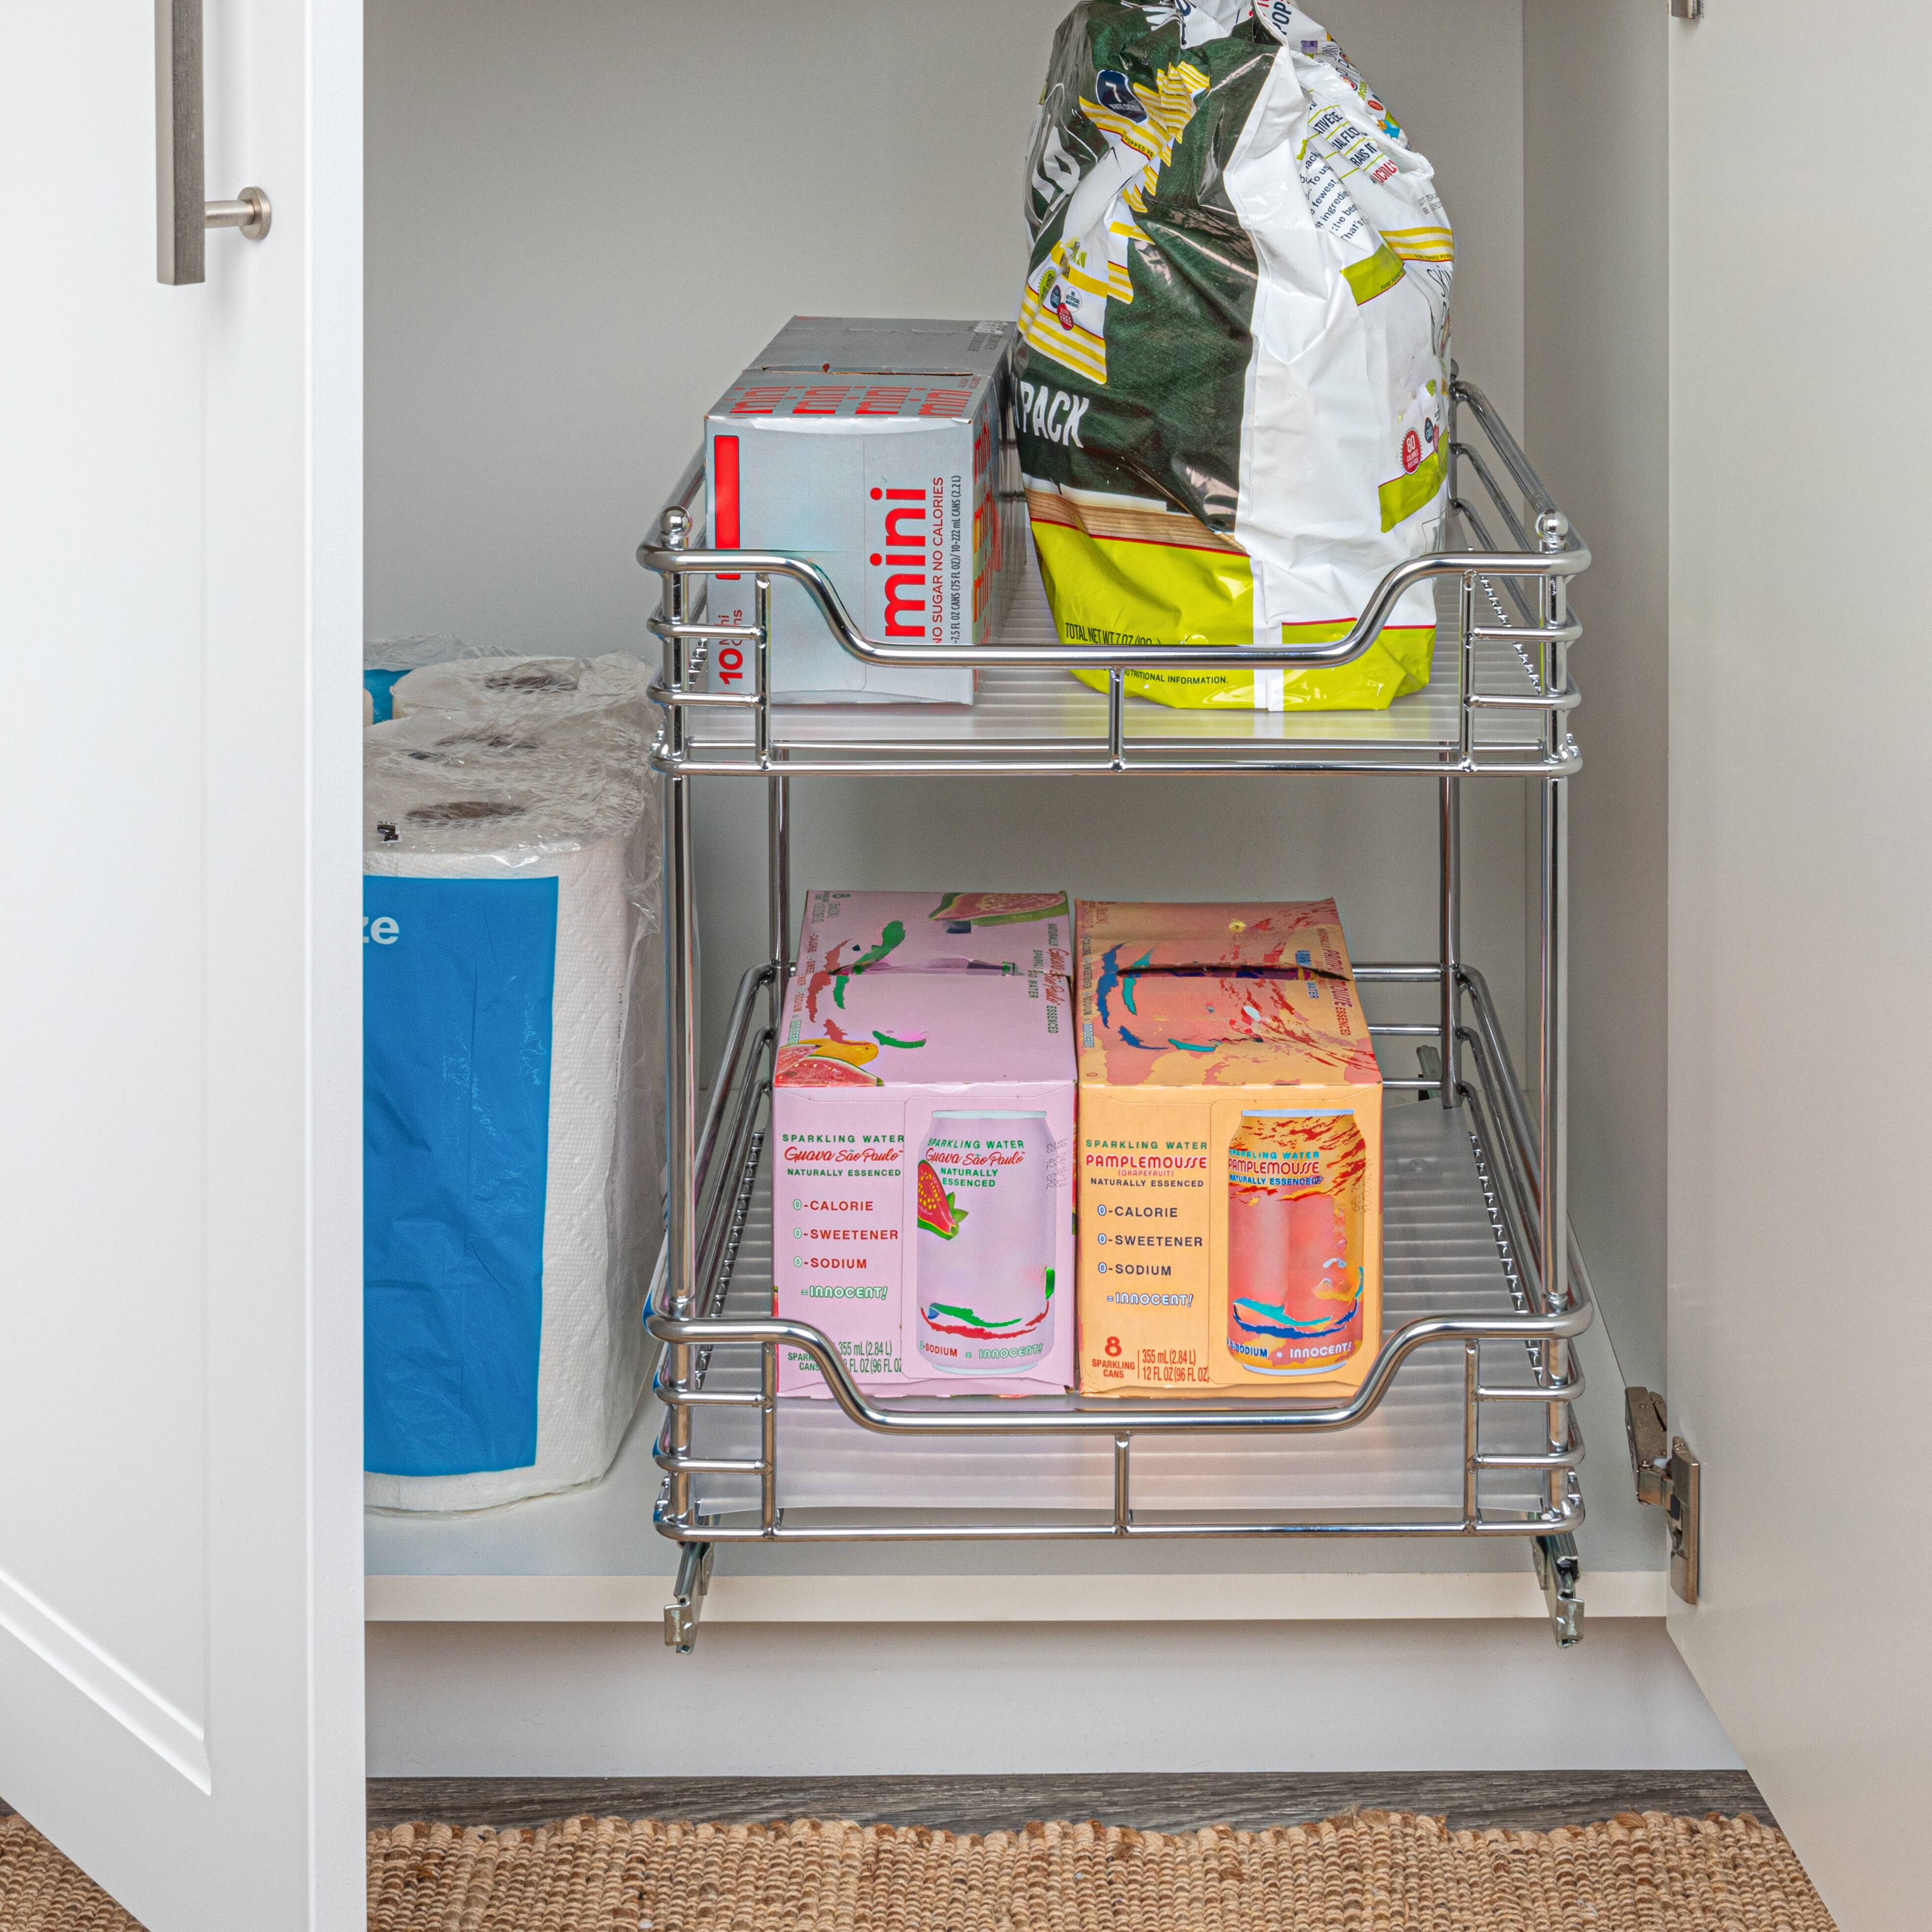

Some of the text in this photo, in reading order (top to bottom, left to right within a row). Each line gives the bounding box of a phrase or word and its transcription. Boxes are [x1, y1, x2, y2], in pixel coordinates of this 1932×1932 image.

[1105, 82, 1122, 102] 7
[1125, 136, 1145, 152] POPPED
[1308, 175, 1320, 185] To
[1060, 312, 1073, 327] FREE
[908, 386, 973, 417] mini
[1020, 381, 1090, 448] PACK
[1406, 435, 1416, 453] 80
[951, 483, 961, 498] (2.2
[932, 477, 944, 546] CALORIES
[951, 499, 961, 517] CANS
[952, 518, 961, 528] mL
[951, 530, 961, 552] 10-222
[870, 487, 926, 637] mini
[932, 550, 943, 571] NO
[950, 579, 961, 591] (75
[932, 575, 943, 623] SUGAR
[951, 593, 960, 610] CANS
[951, 612, 960, 621] OZ
[1065, 623, 1088, 641] TOTAL
[1088, 627, 1102, 644] NET
[1102, 630, 1115, 644] WT
[718, 648, 743, 685] 10
[363, 916, 400, 945] e
[1322, 948, 1353, 1007] PAMPLMOUSSE
[1029, 980, 1039, 998] WATER
[1046, 1006, 1059, 1034] ESSENCED
[1335, 1007, 1351, 1036] ESSENCED
[782, 1134, 904, 1143] SPARKLING WATER
[927, 1138, 1025, 1149] SPARKLING WATER
[1086, 1140, 1208, 1150] SPARKLING WATER
[784, 1146, 836, 1163] Guava
[835, 1148, 863, 1162] São
[925, 1147, 962, 1164] Guava
[962, 1153, 990, 1166] São
[1086, 1154, 1207, 1169] PAMPLEMOUSSE
[1229, 1148, 1320, 1159] SPARKLING WATER
[787, 1168, 844, 1176] NATURALLY
[940, 1167, 998, 1177] NATURALLY
[1228, 1158, 1320, 1175] PAMPLEMOUSSE
[942, 1177, 996, 1187] ESSENCED
[1090, 1178, 1146, 1187] NATURALLY
[1229, 1174, 1266, 1185] NATURALLY
[793, 1198, 873, 1211] 0-CALORIE
[1097, 1204, 1178, 1218] 0-CALORIE
[793, 1227, 898, 1240] 0-SWEETENER
[1097, 1233, 1203, 1247] 0-SWEETENER
[793, 1256, 867, 1269] 0-SODIUM
[1098, 1262, 1171, 1276] 0-SODIUM
[838, 1340, 892, 1357] 355 mL (2.84 L)
[979, 1343, 1043, 1359] INNOCENT!
[1105, 1336, 1122, 1357] 8
[1289, 1341, 1352, 1359] INNOCENT!
[849, 1358, 858, 1372] FL
[860, 1358, 869, 1373] OZ
[870, 1357, 881, 1374] (96
[884, 1358, 893, 1372] FL
[1092, 1359, 1135, 1370] SPARKLING
[1142, 1348, 1196, 1366] 355 mL (2.84 L)
[1103, 1369, 1124, 1379] CANS
[1143, 1366, 1151, 1380] 12
[1153, 1366, 1162, 1381] FL
[1164, 1367, 1173, 1381] OZ
[1174, 1366, 1186, 1383] (96
[1188, 1367, 1196, 1382] FL
